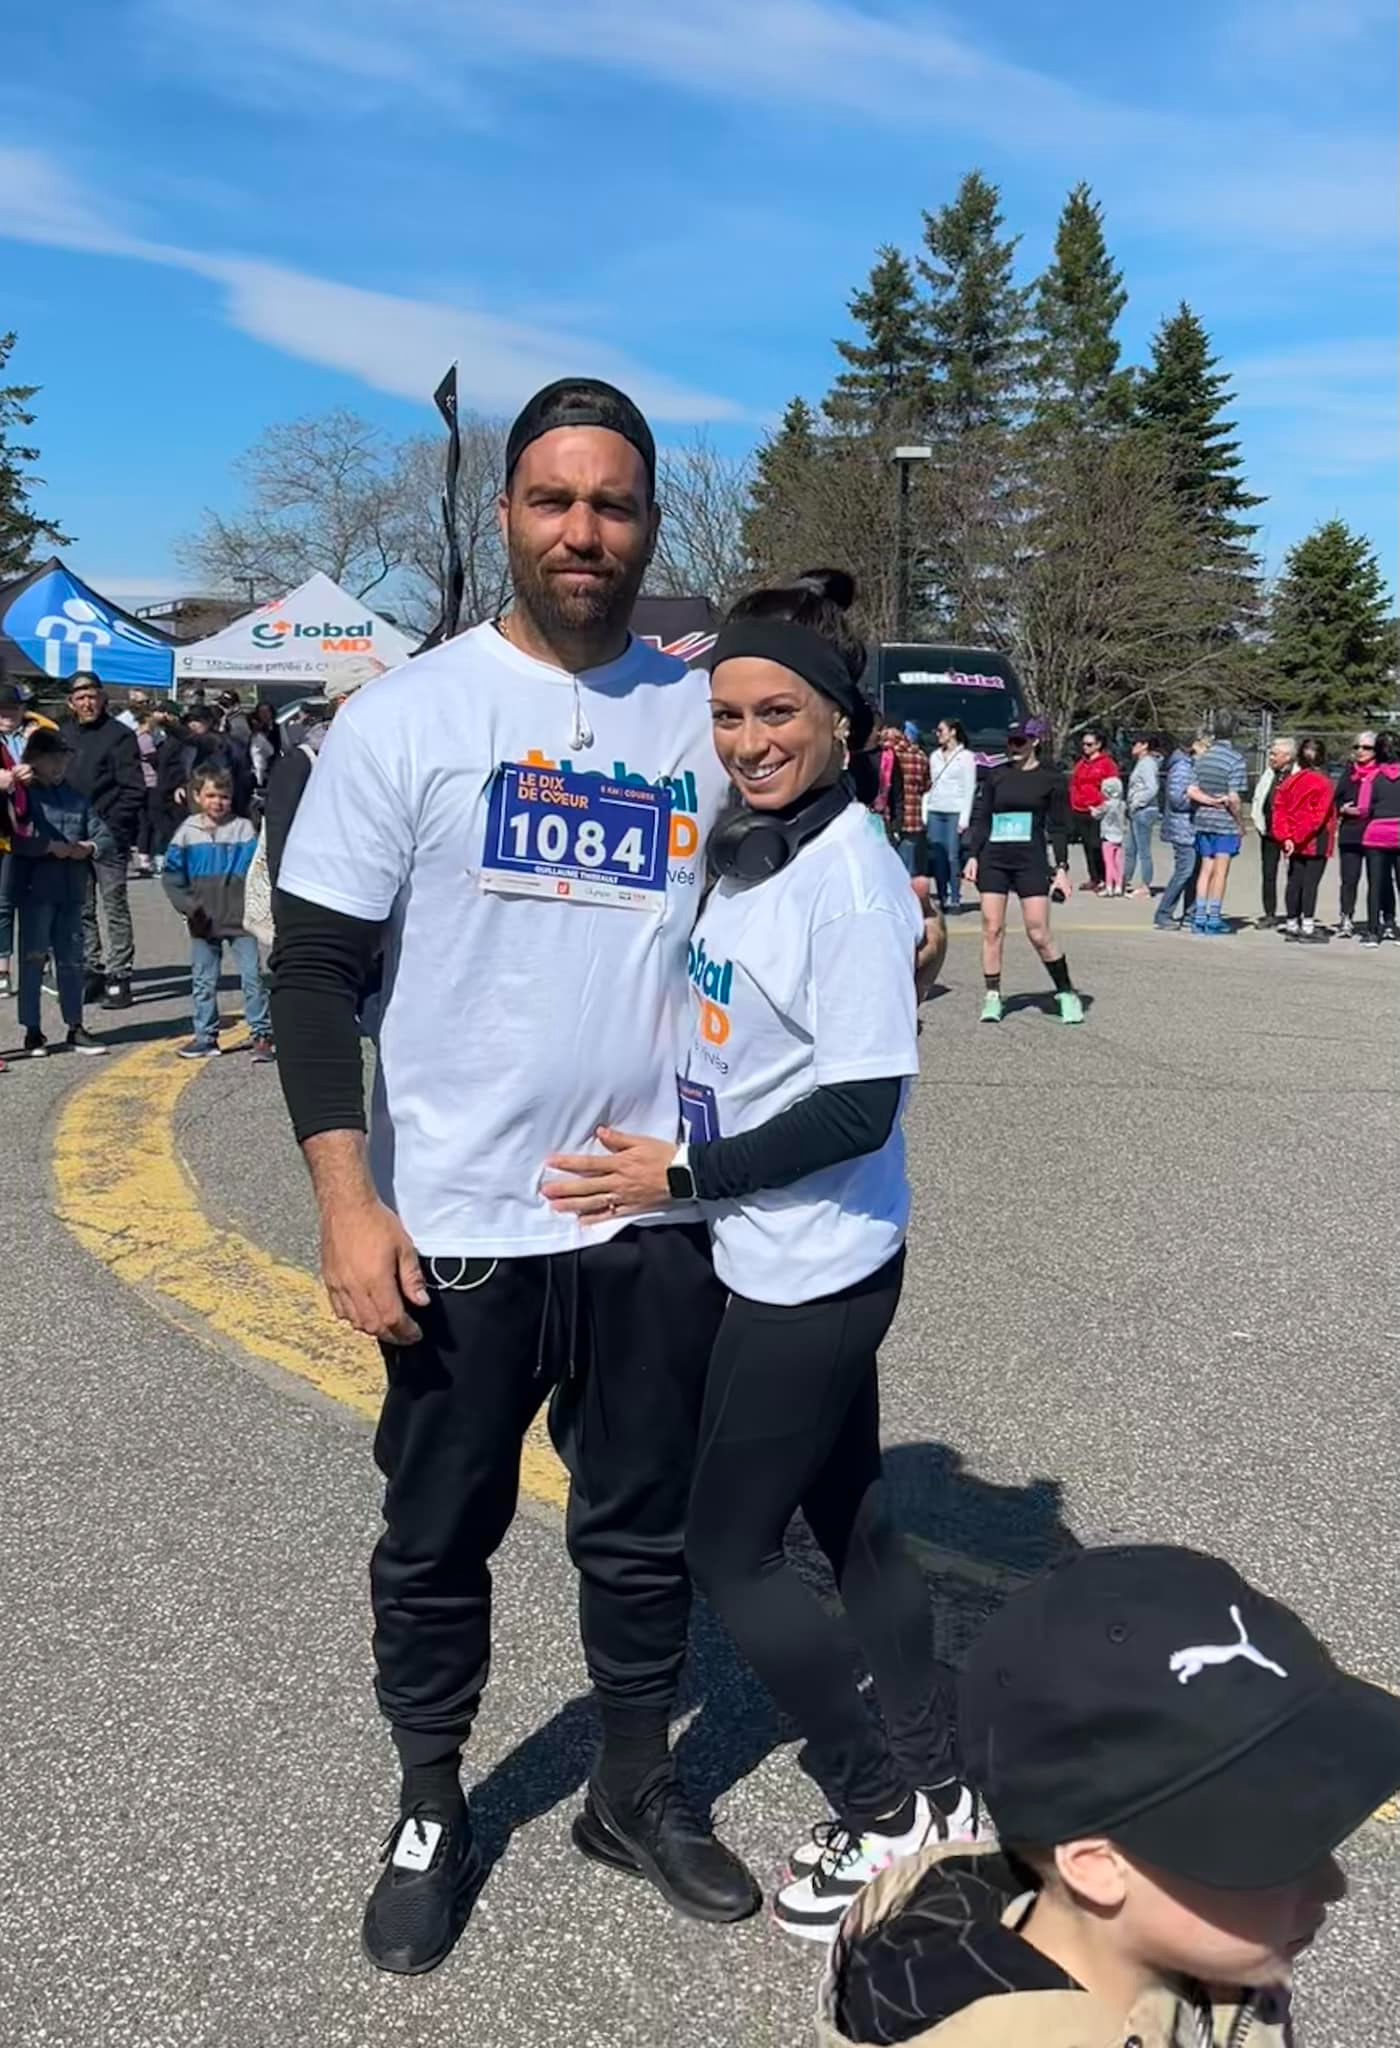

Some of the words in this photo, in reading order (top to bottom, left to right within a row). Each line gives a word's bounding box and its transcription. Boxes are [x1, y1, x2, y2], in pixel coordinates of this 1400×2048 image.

[320, 638, 372, 651] MD
[518, 772, 537, 787] LE
[539, 775, 565, 791] DIX
[518, 786, 538, 802] DE
[509, 812, 646, 873] 1084
